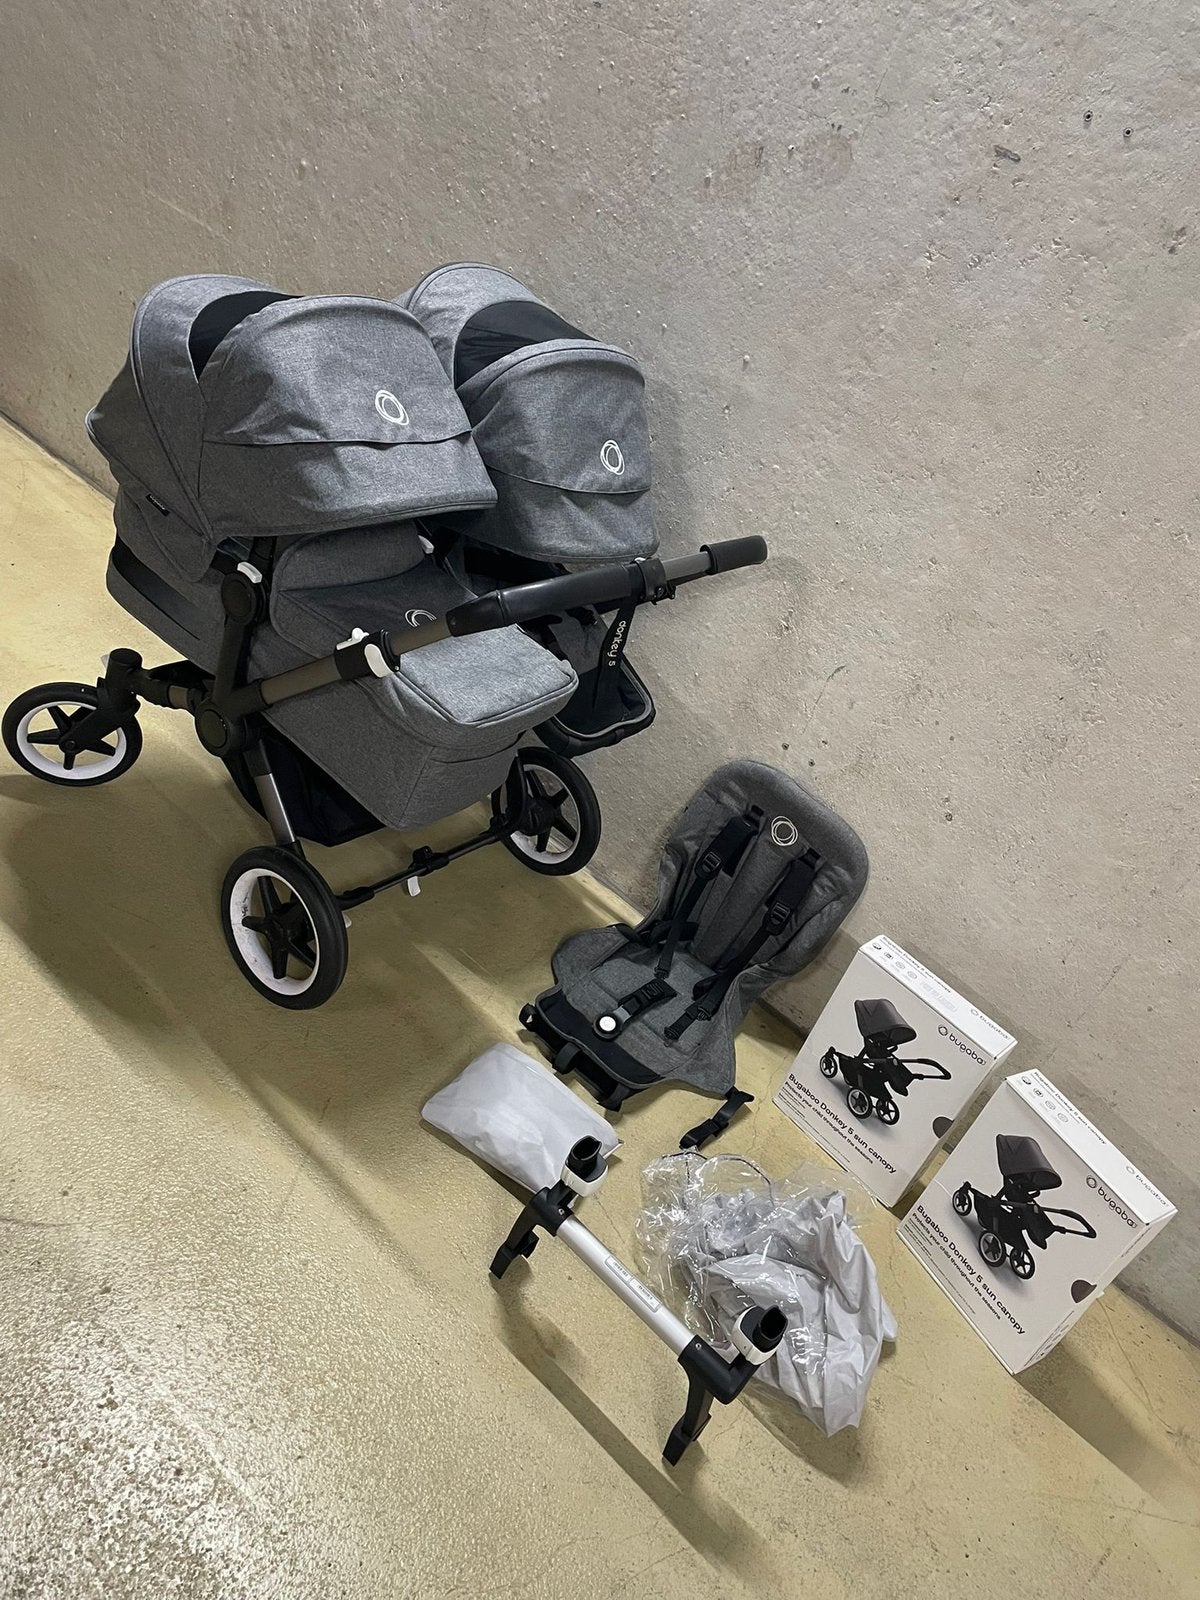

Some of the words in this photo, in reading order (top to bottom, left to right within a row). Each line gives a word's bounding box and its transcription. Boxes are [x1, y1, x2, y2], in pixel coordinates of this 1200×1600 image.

[607, 620, 626, 657] donkey
[789, 1073, 820, 1104] Bugaboo
[820, 1102, 848, 1129] Donkey
[848, 1127, 855, 1135] 5
[853, 1134, 868, 1148] sun
[868, 1147, 897, 1174] canopy
[812, 1107, 824, 1118] child
[823, 1116, 848, 1140] throughout
[912, 1212, 930, 1235] Protects
[930, 1234, 941, 1245] your
[940, 1245, 951, 1259] child
[950, 1257, 975, 1288] throughout
[974, 1286, 982, 1297] the
[981, 1296, 1001, 1320] seasons
[917, 1205, 949, 1243] Bugaboo
[948, 1241, 976, 1276] Donkey
[976, 1274, 983, 1283] 5
[981, 1283, 997, 1301] sun
[996, 1300, 1026, 1335] canopy
